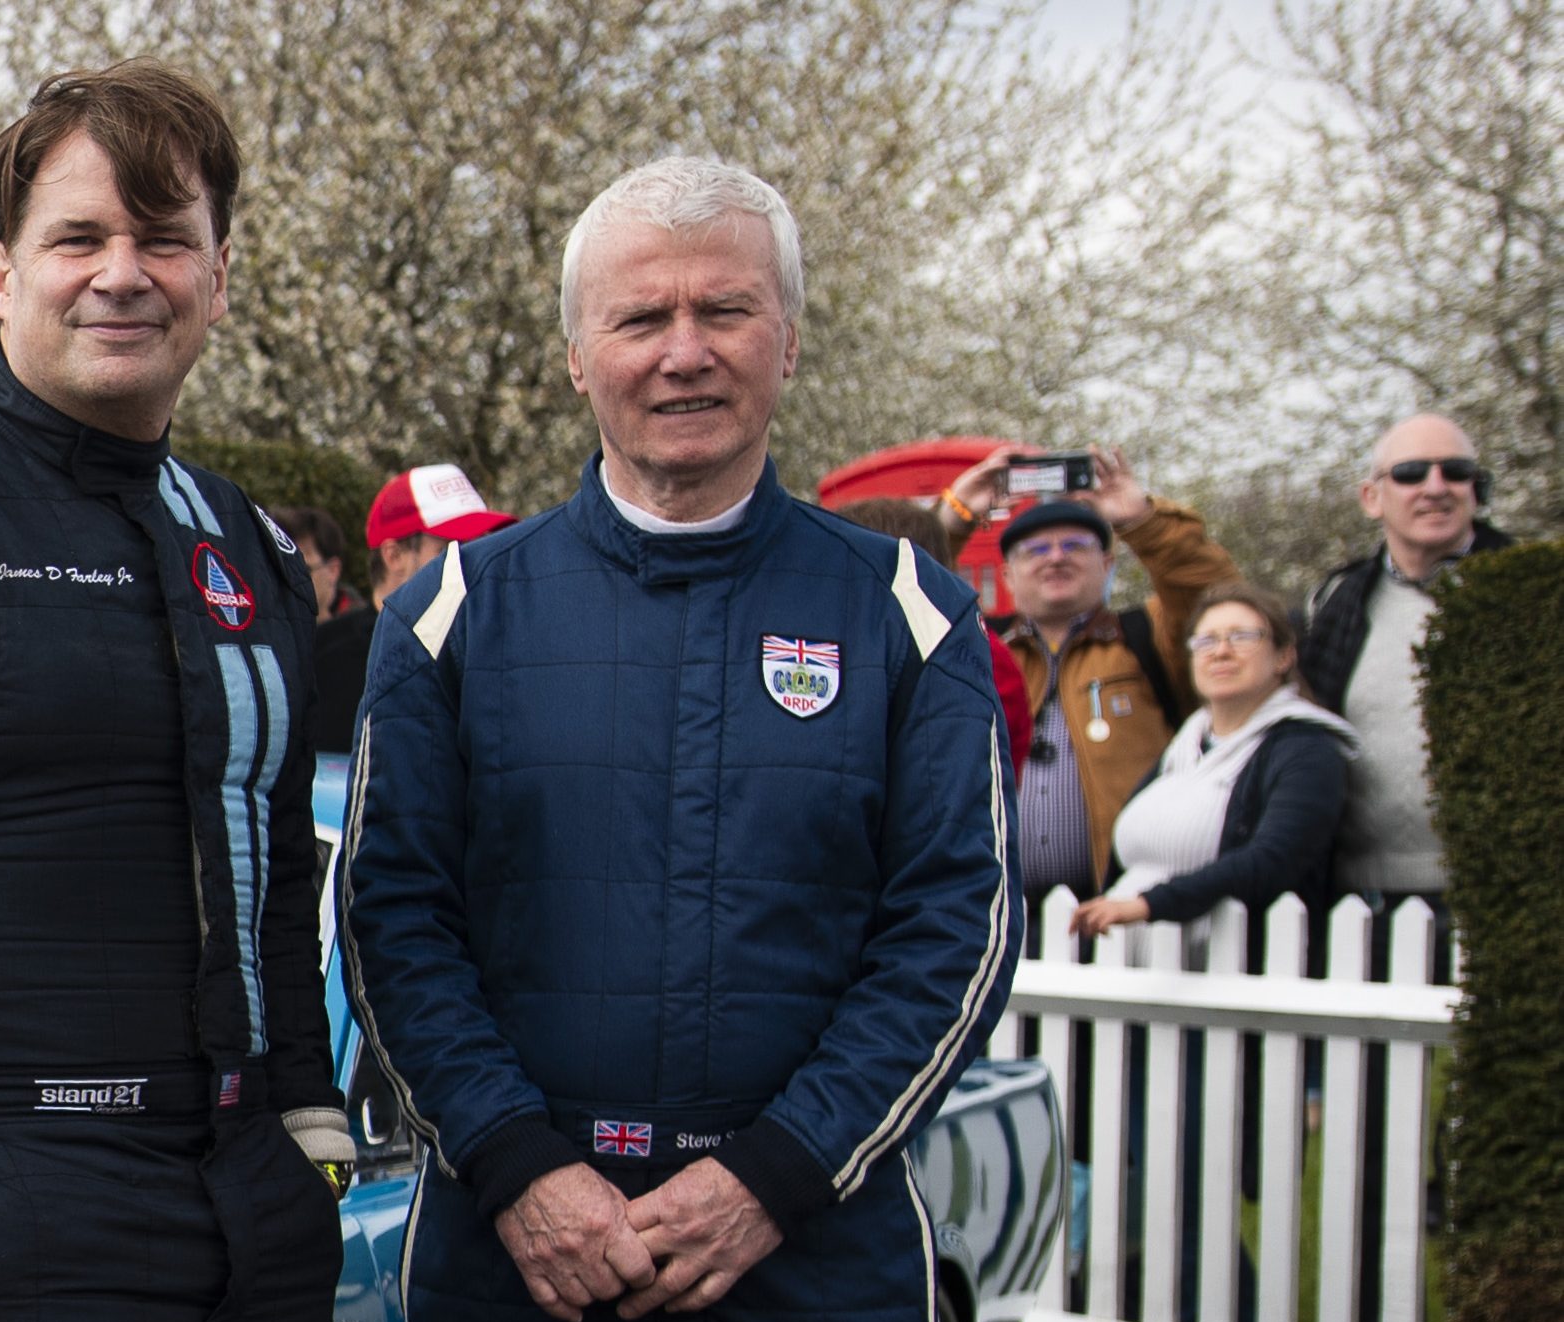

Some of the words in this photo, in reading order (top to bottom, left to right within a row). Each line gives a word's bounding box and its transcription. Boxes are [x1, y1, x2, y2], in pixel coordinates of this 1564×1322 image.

[45, 566, 62, 580] D
[66, 567, 114, 586] Farley
[118, 567, 134, 585] Jr
[204, 588, 251, 608] COBRA
[783, 696, 819, 712] BRDC
[676, 1132, 721, 1149] Steve
